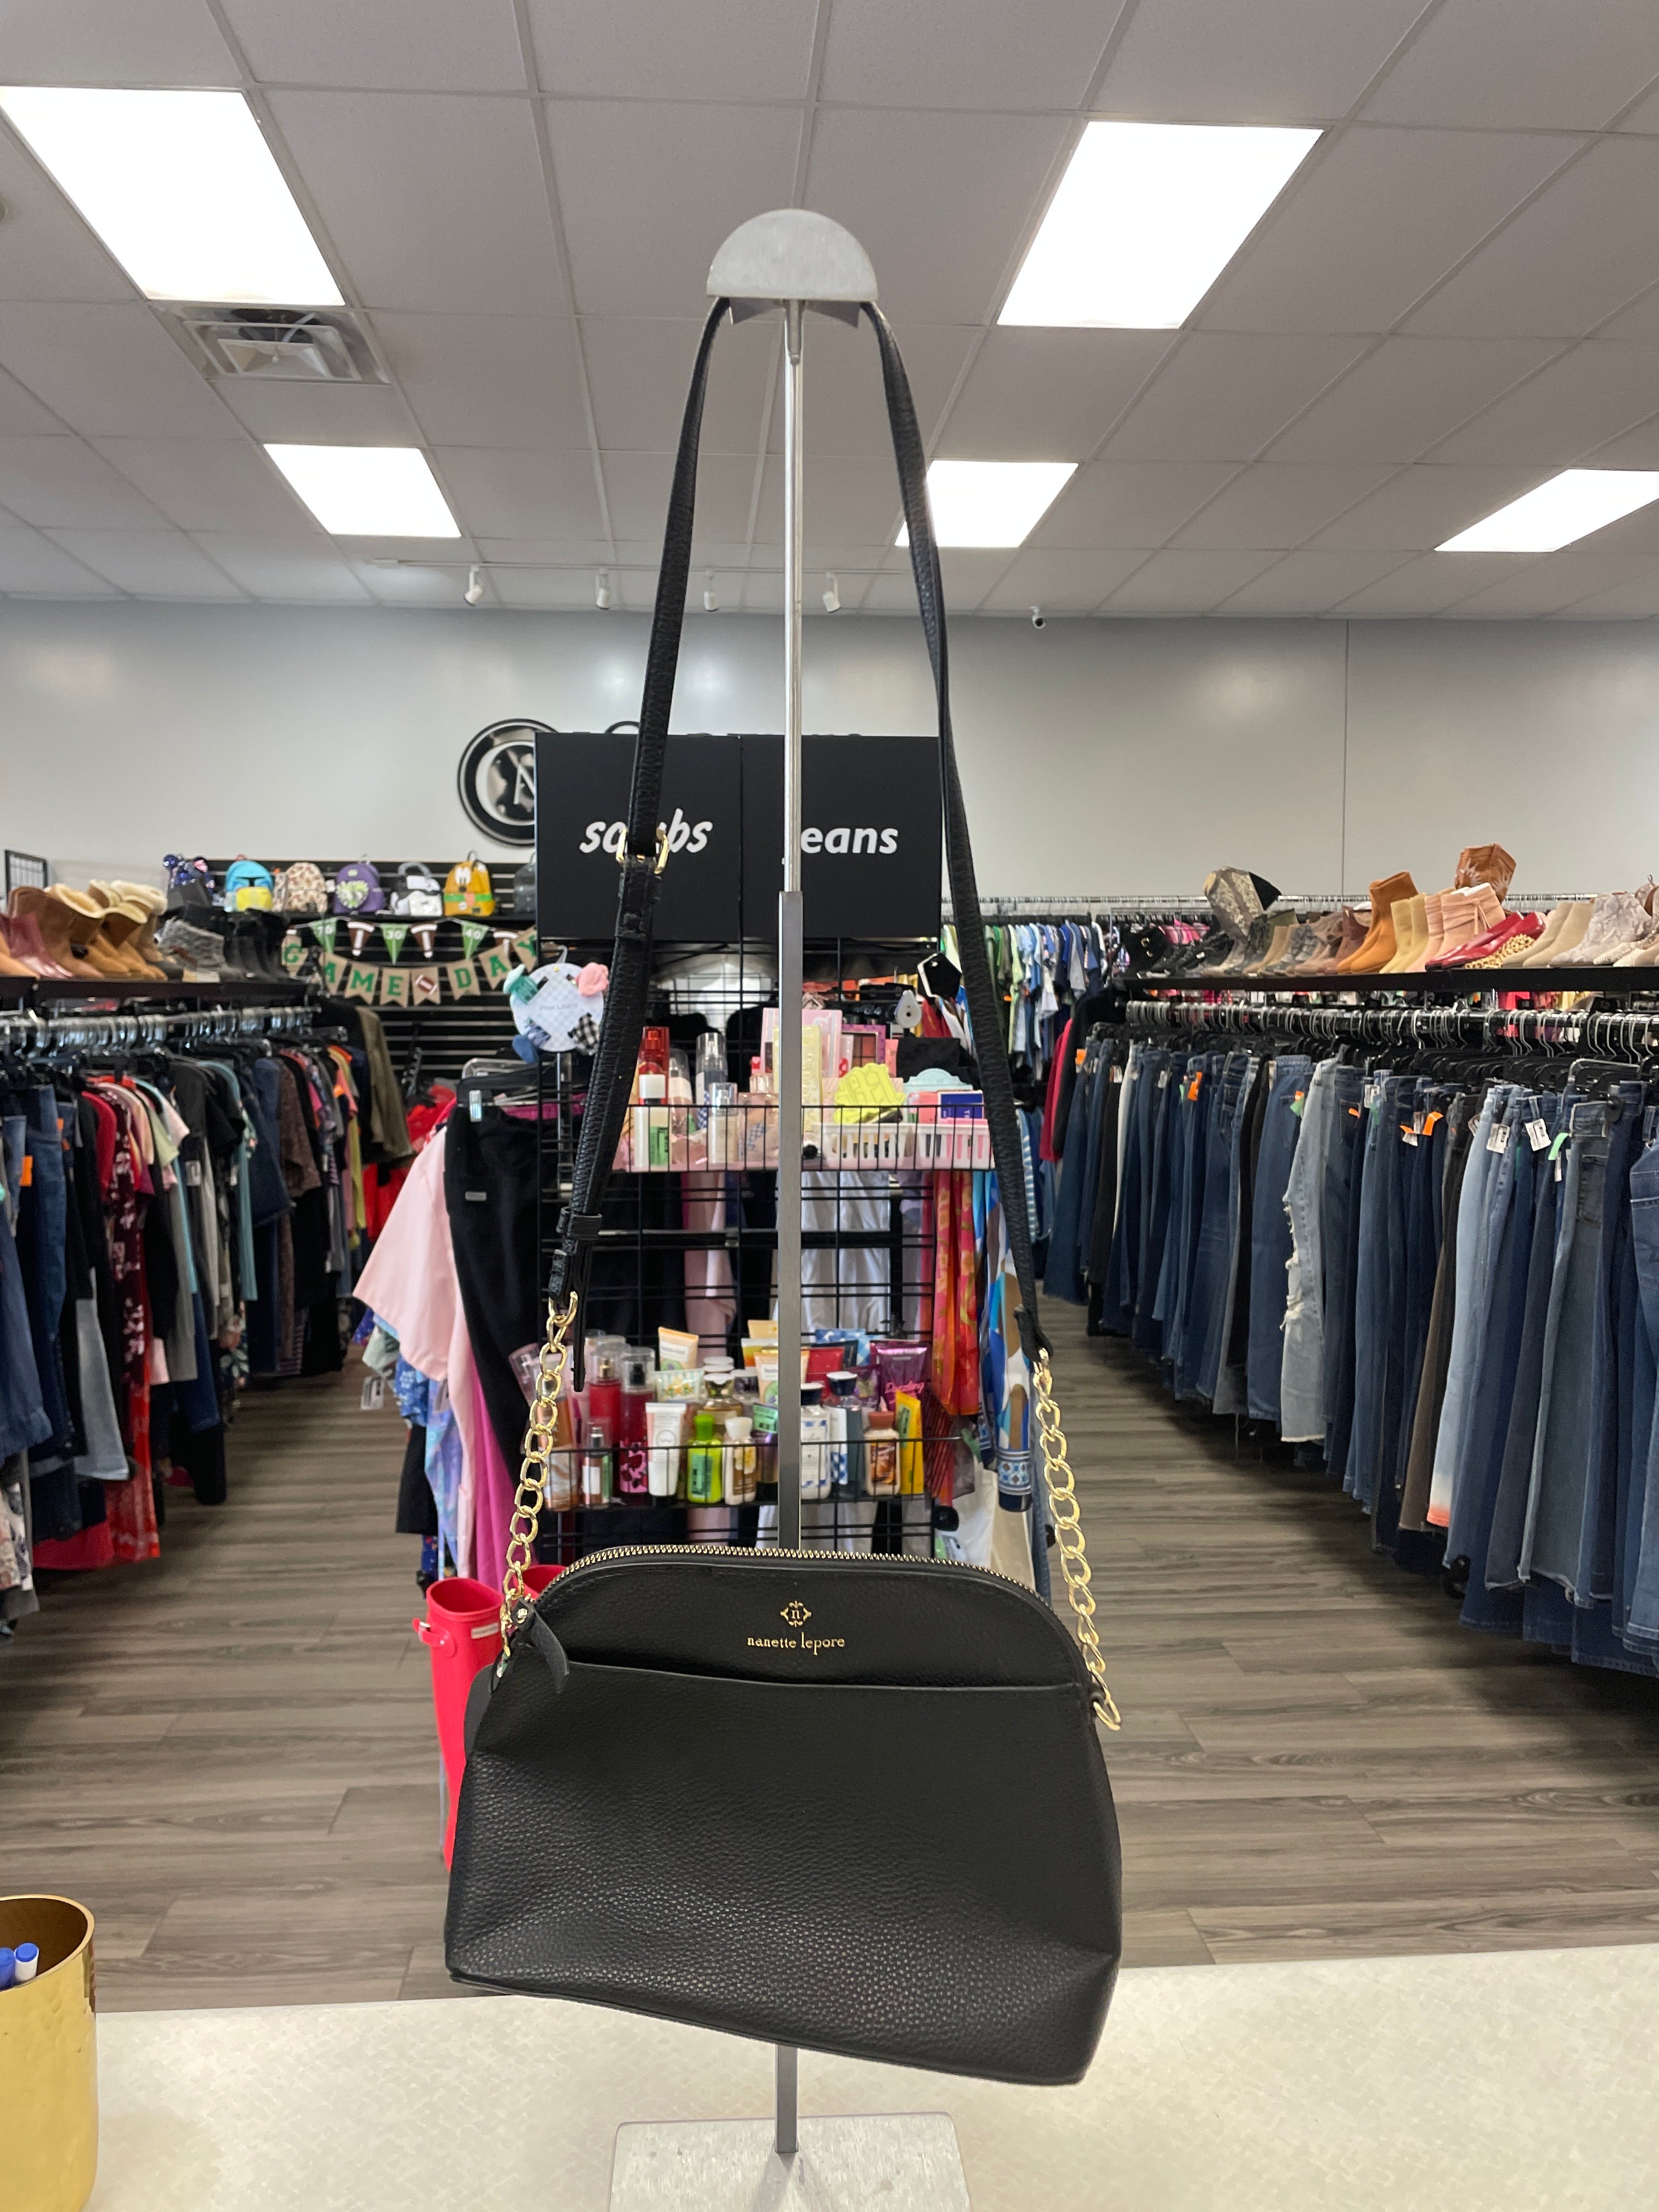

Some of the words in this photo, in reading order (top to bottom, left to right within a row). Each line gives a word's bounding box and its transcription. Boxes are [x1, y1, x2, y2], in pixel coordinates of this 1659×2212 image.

[579, 808, 713, 854] scbs
[781, 827, 899, 865] eans
[747, 1637, 797, 1649] nanette
[800, 1632, 845, 1656] lepore
